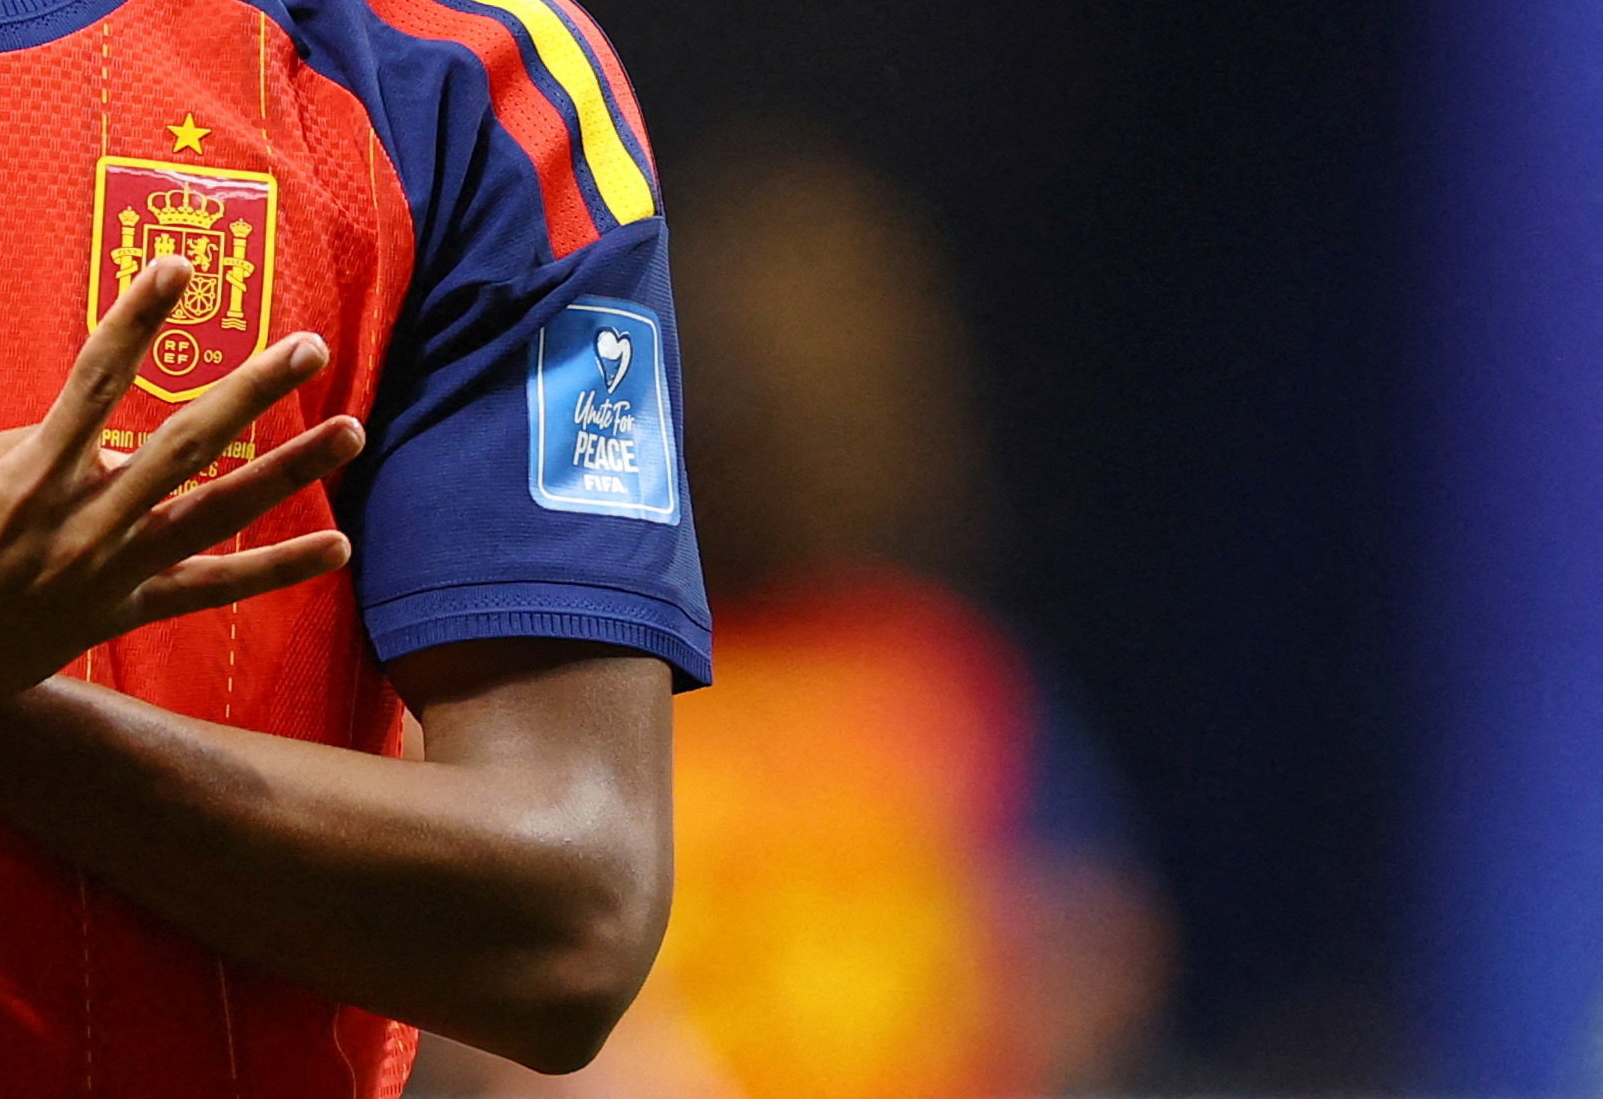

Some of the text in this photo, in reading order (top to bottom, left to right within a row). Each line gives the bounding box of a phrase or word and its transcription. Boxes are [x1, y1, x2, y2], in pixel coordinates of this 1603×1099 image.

[203, 349, 223, 364] 09
[574, 390, 635, 435] Unite For
[101, 428, 134, 449] PAIN
[573, 430, 638, 473] PEACE
[582, 474, 626, 493] FIFA
